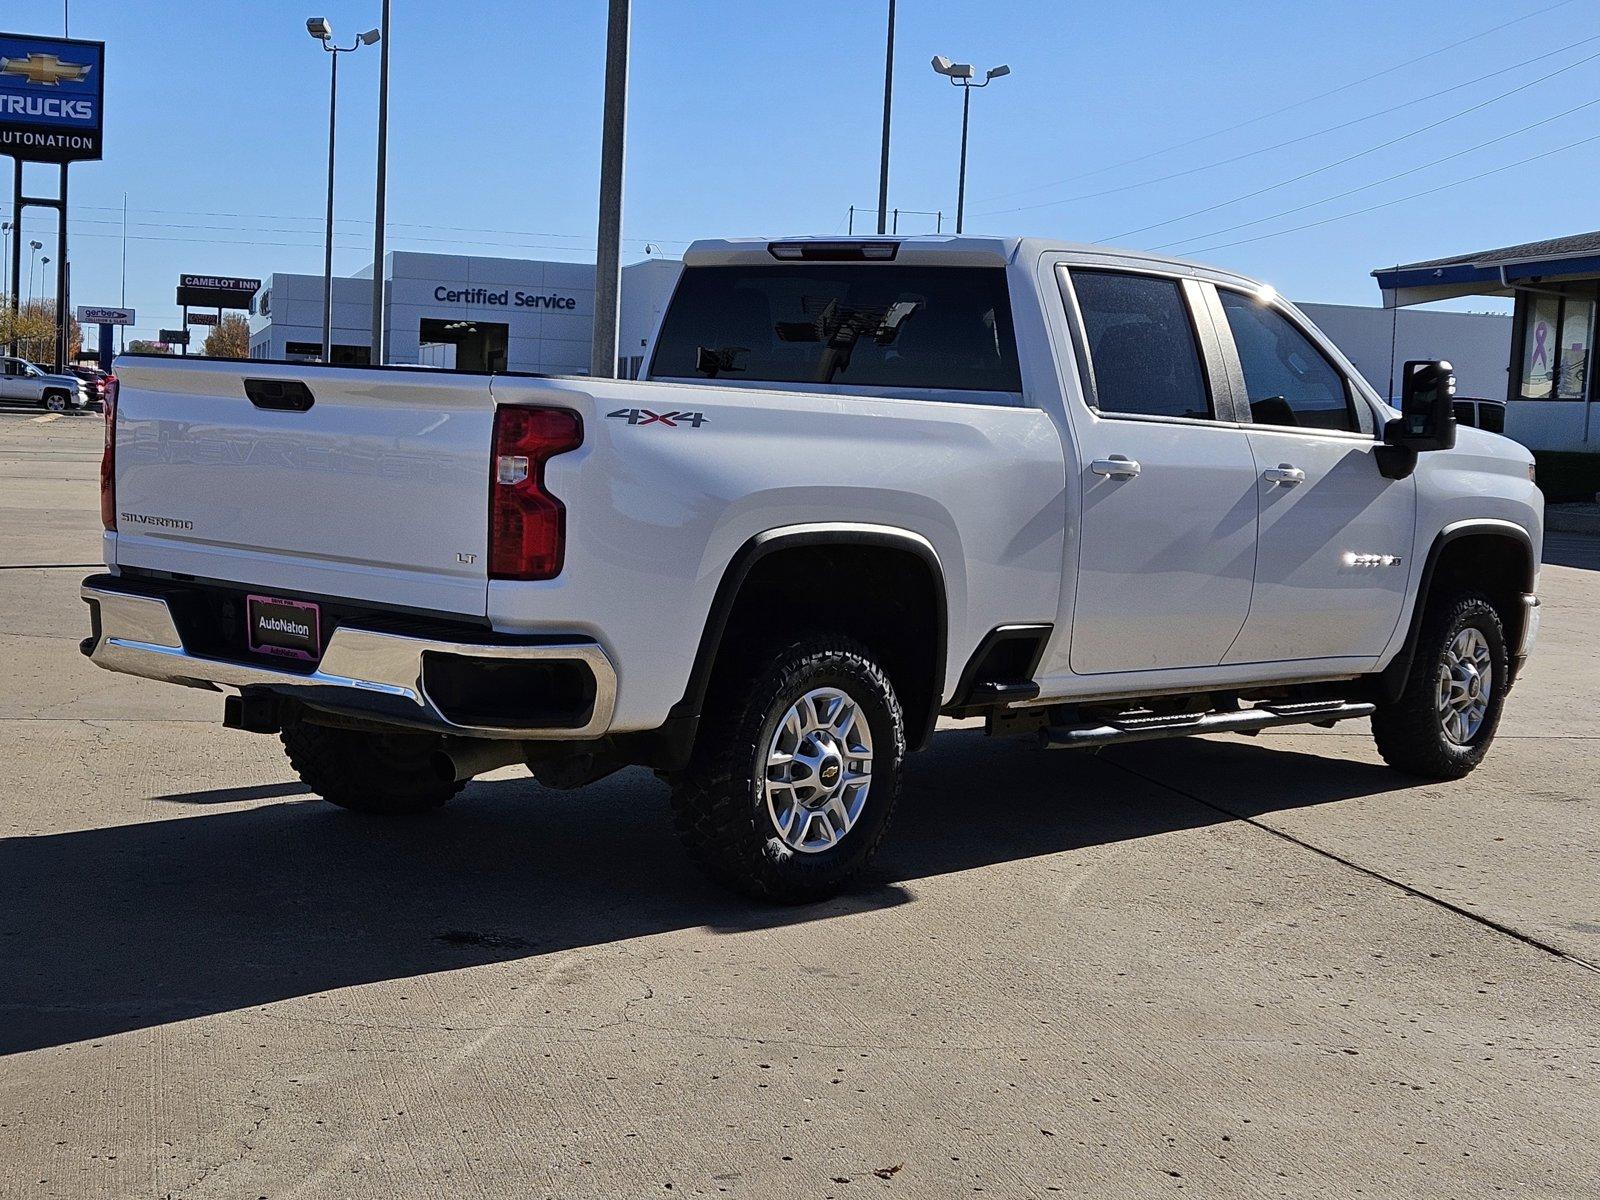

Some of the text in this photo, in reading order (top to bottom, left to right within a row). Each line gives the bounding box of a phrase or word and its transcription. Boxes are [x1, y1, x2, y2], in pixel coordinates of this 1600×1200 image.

[0, 131, 93, 149] UTONATION
[185, 277, 258, 289] CAMELOT INN
[434, 285, 576, 310] Certified Service
[85, 308, 117, 318] gerber
[120, 511, 194, 531] SILVERADO
[456, 552, 478, 565] LT
[259, 616, 309, 635] AutoNation
